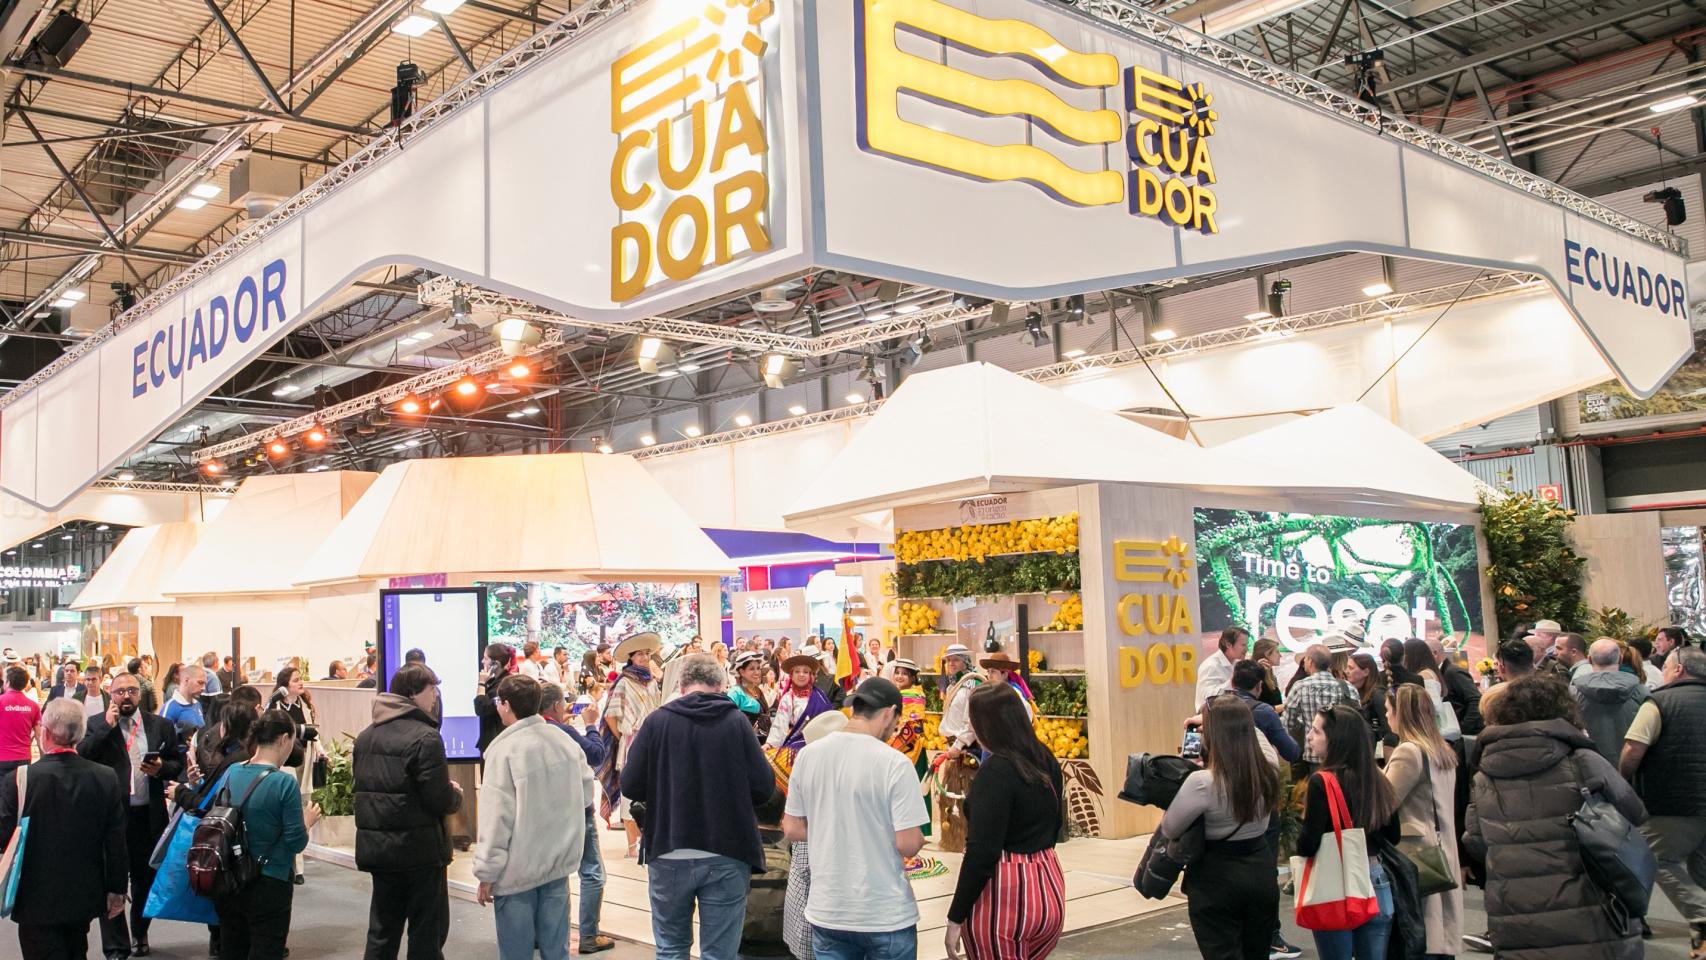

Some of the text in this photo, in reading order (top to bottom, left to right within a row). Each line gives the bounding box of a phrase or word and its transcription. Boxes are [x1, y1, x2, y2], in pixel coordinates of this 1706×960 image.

[611, 80, 769, 211] CUA
[1126, 119, 1217, 186] CUA
[1128, 168, 1219, 235] DOR
[611, 170, 770, 303] DOR
[1564, 239, 1687, 320] ECUADOR
[132, 258, 287, 399] ECUADOR
[977, 497, 1007, 506] ECUADOR
[45, 580, 73, 588] BELLZA
[1241, 550, 1331, 585] Time to
[755, 599, 789, 609] LATAM
[1117, 592, 1196, 637] CUA
[1119, 642, 1198, 689] DOR
